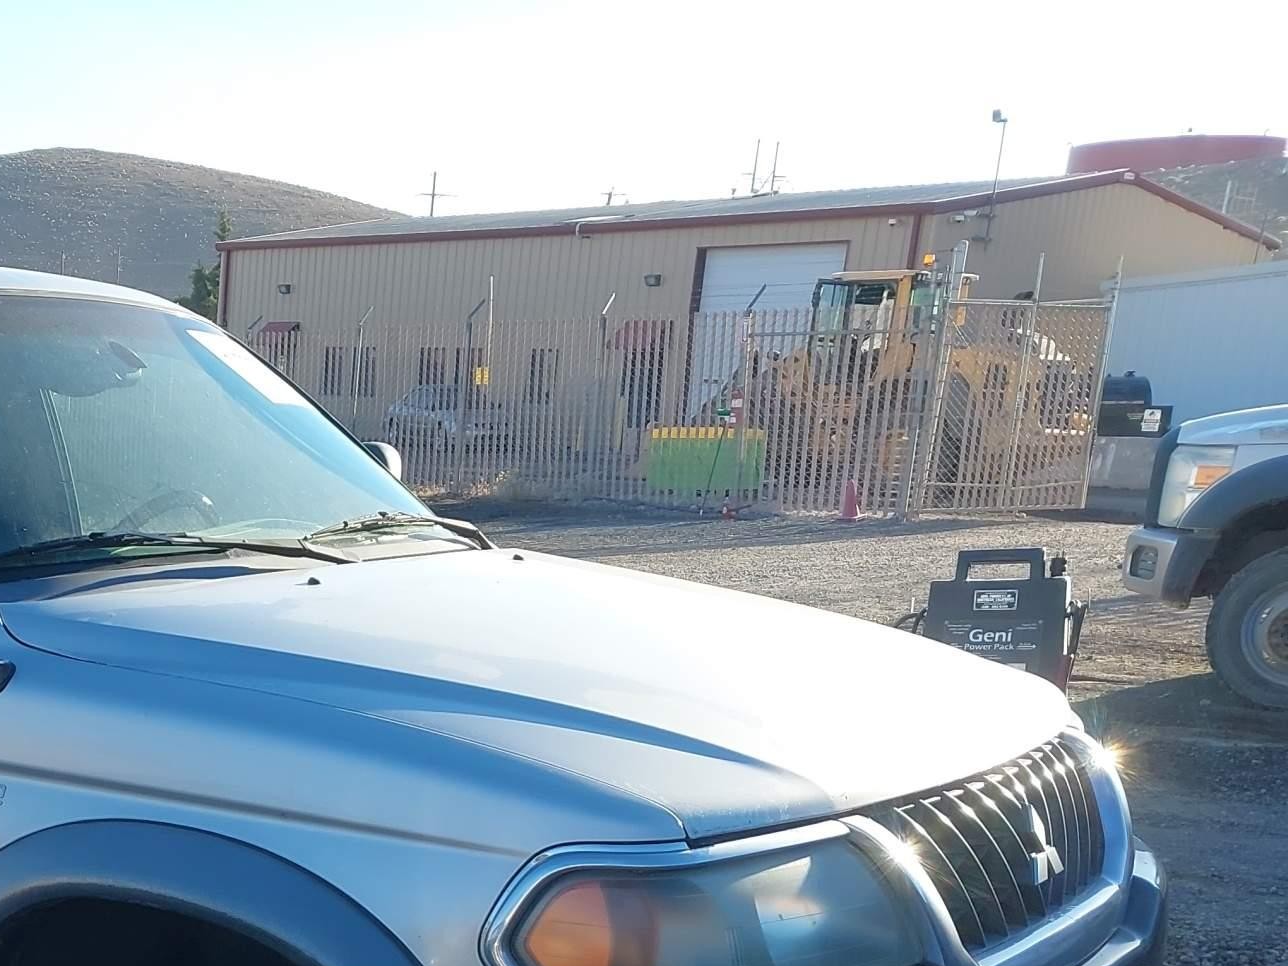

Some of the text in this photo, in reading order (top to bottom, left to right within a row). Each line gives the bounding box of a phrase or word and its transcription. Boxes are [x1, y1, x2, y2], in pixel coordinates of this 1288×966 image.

[968, 628, 1013, 642] Geni
[964, 643, 992, 651] Power
[993, 643, 1014, 651] Pack
